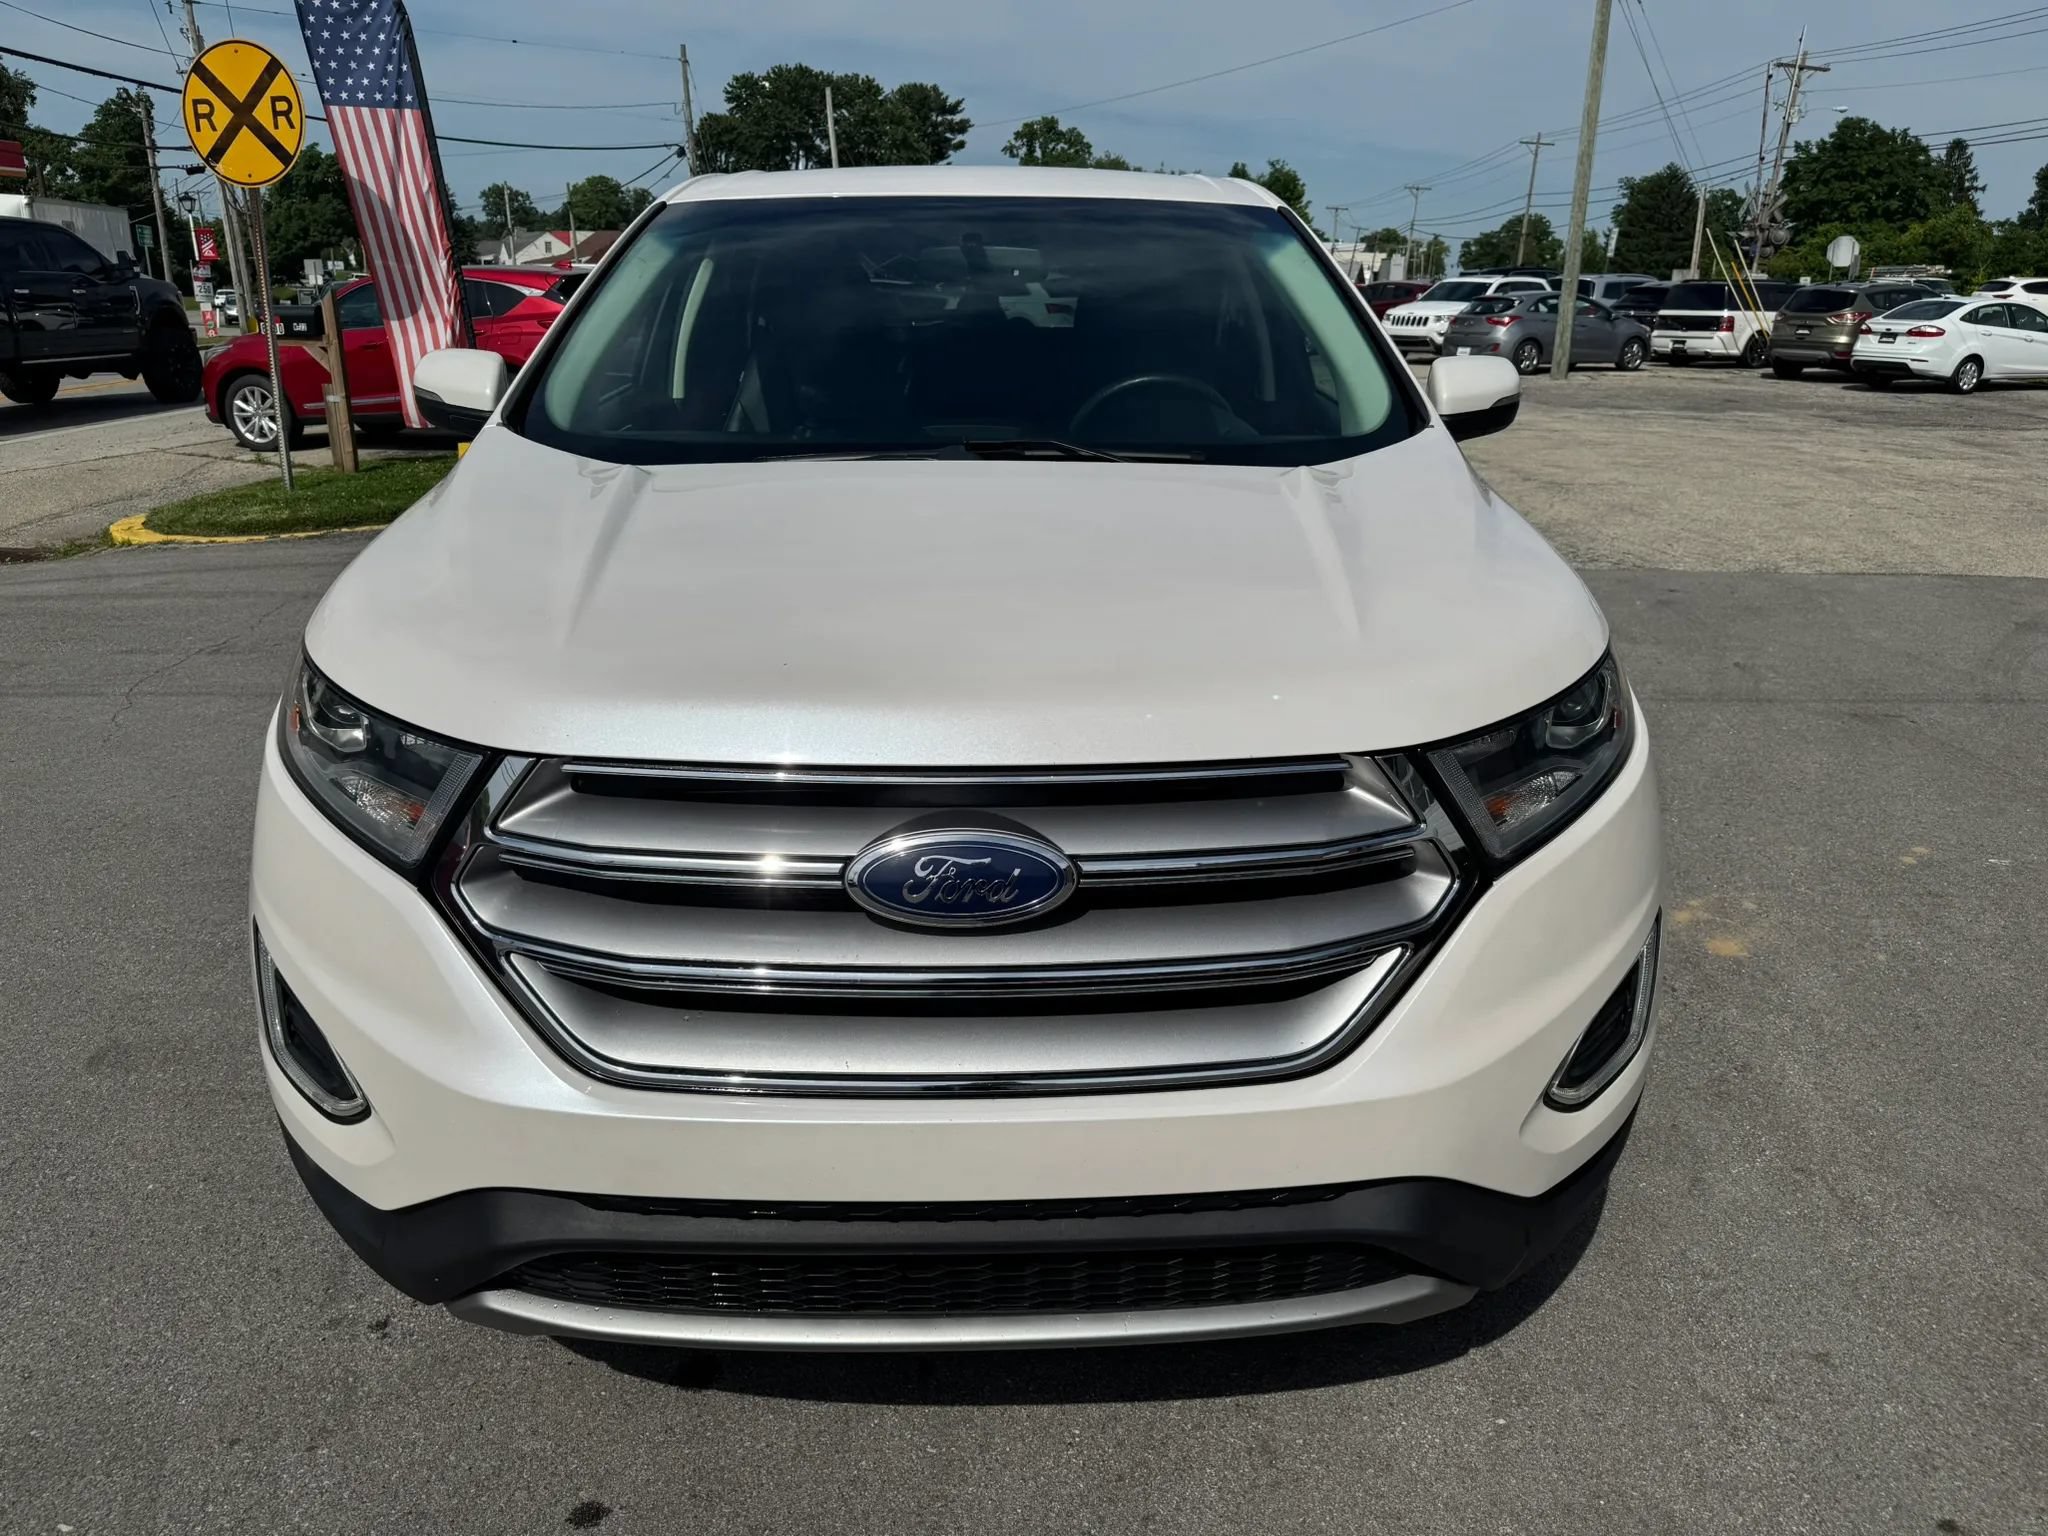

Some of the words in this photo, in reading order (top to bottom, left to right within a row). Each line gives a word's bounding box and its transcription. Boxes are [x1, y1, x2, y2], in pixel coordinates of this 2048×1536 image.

[192, 98, 218, 133] R
[270, 95, 296, 130] R
[903, 854, 1021, 904] Ford
